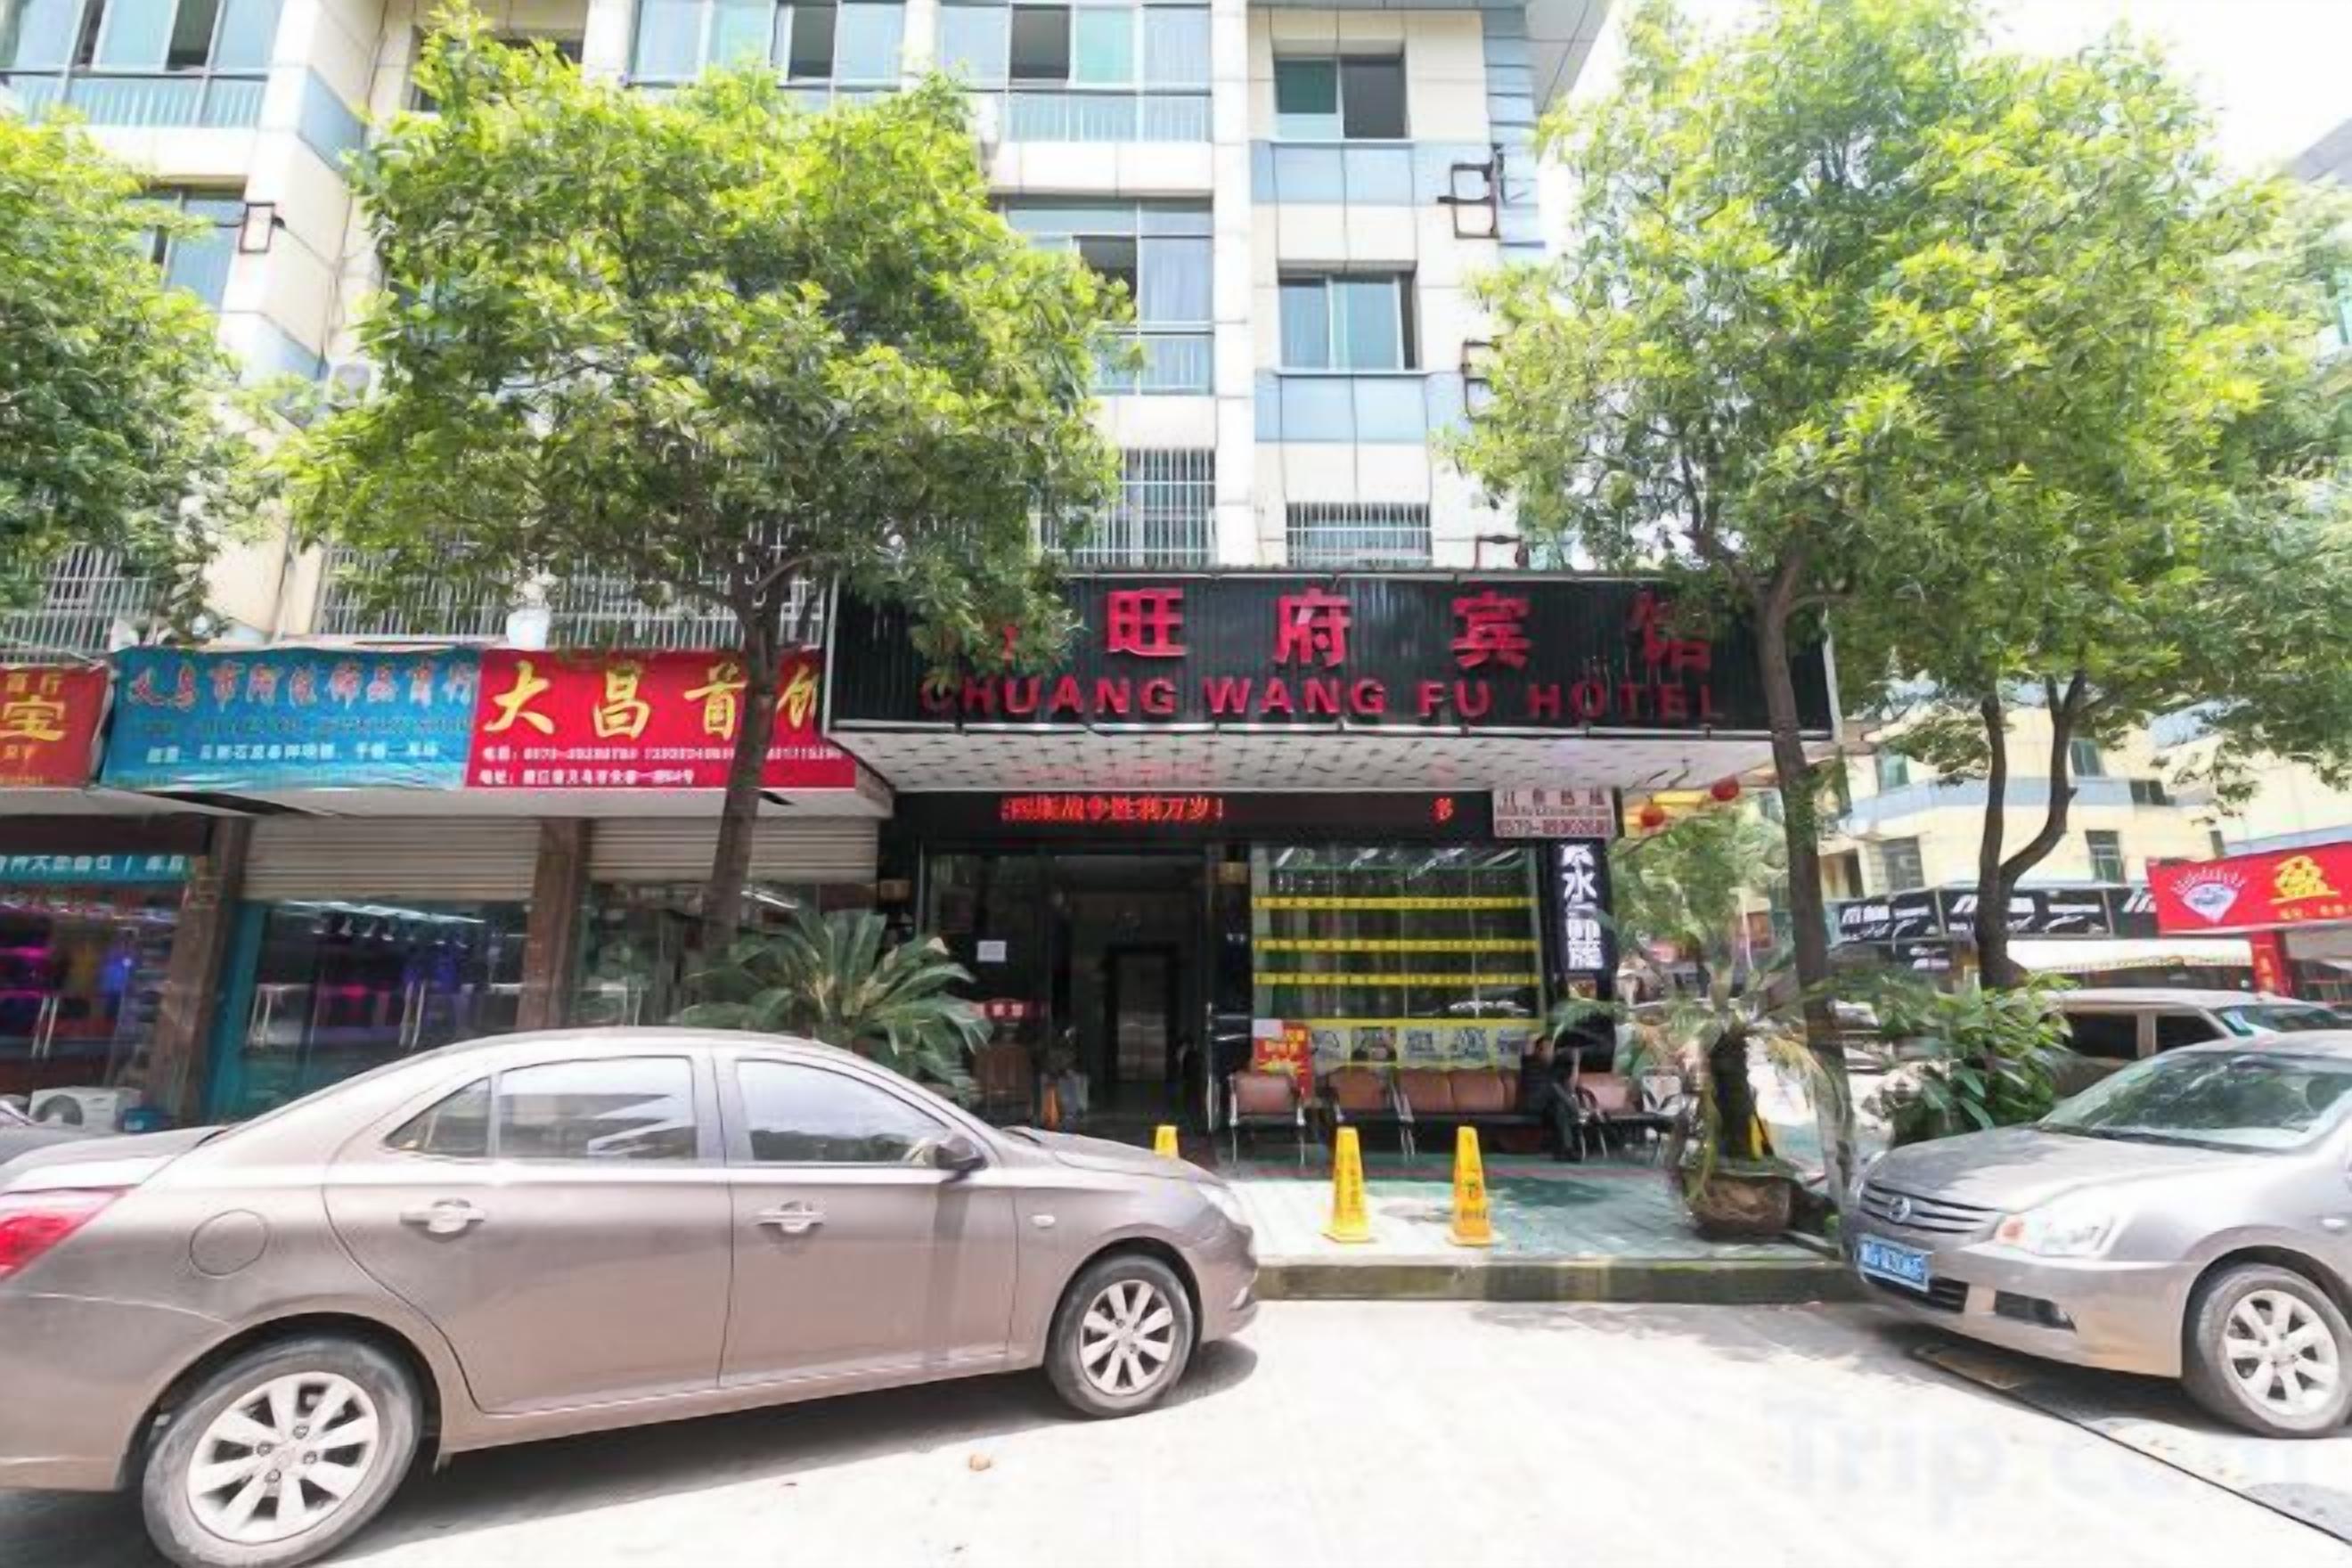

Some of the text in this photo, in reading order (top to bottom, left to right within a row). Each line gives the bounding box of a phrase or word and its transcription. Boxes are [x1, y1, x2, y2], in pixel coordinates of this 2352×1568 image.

[1005, 588, 1712, 671] 旺府宾馆
[920, 675, 1724, 719] CHUANG WANG FU HOTEL
